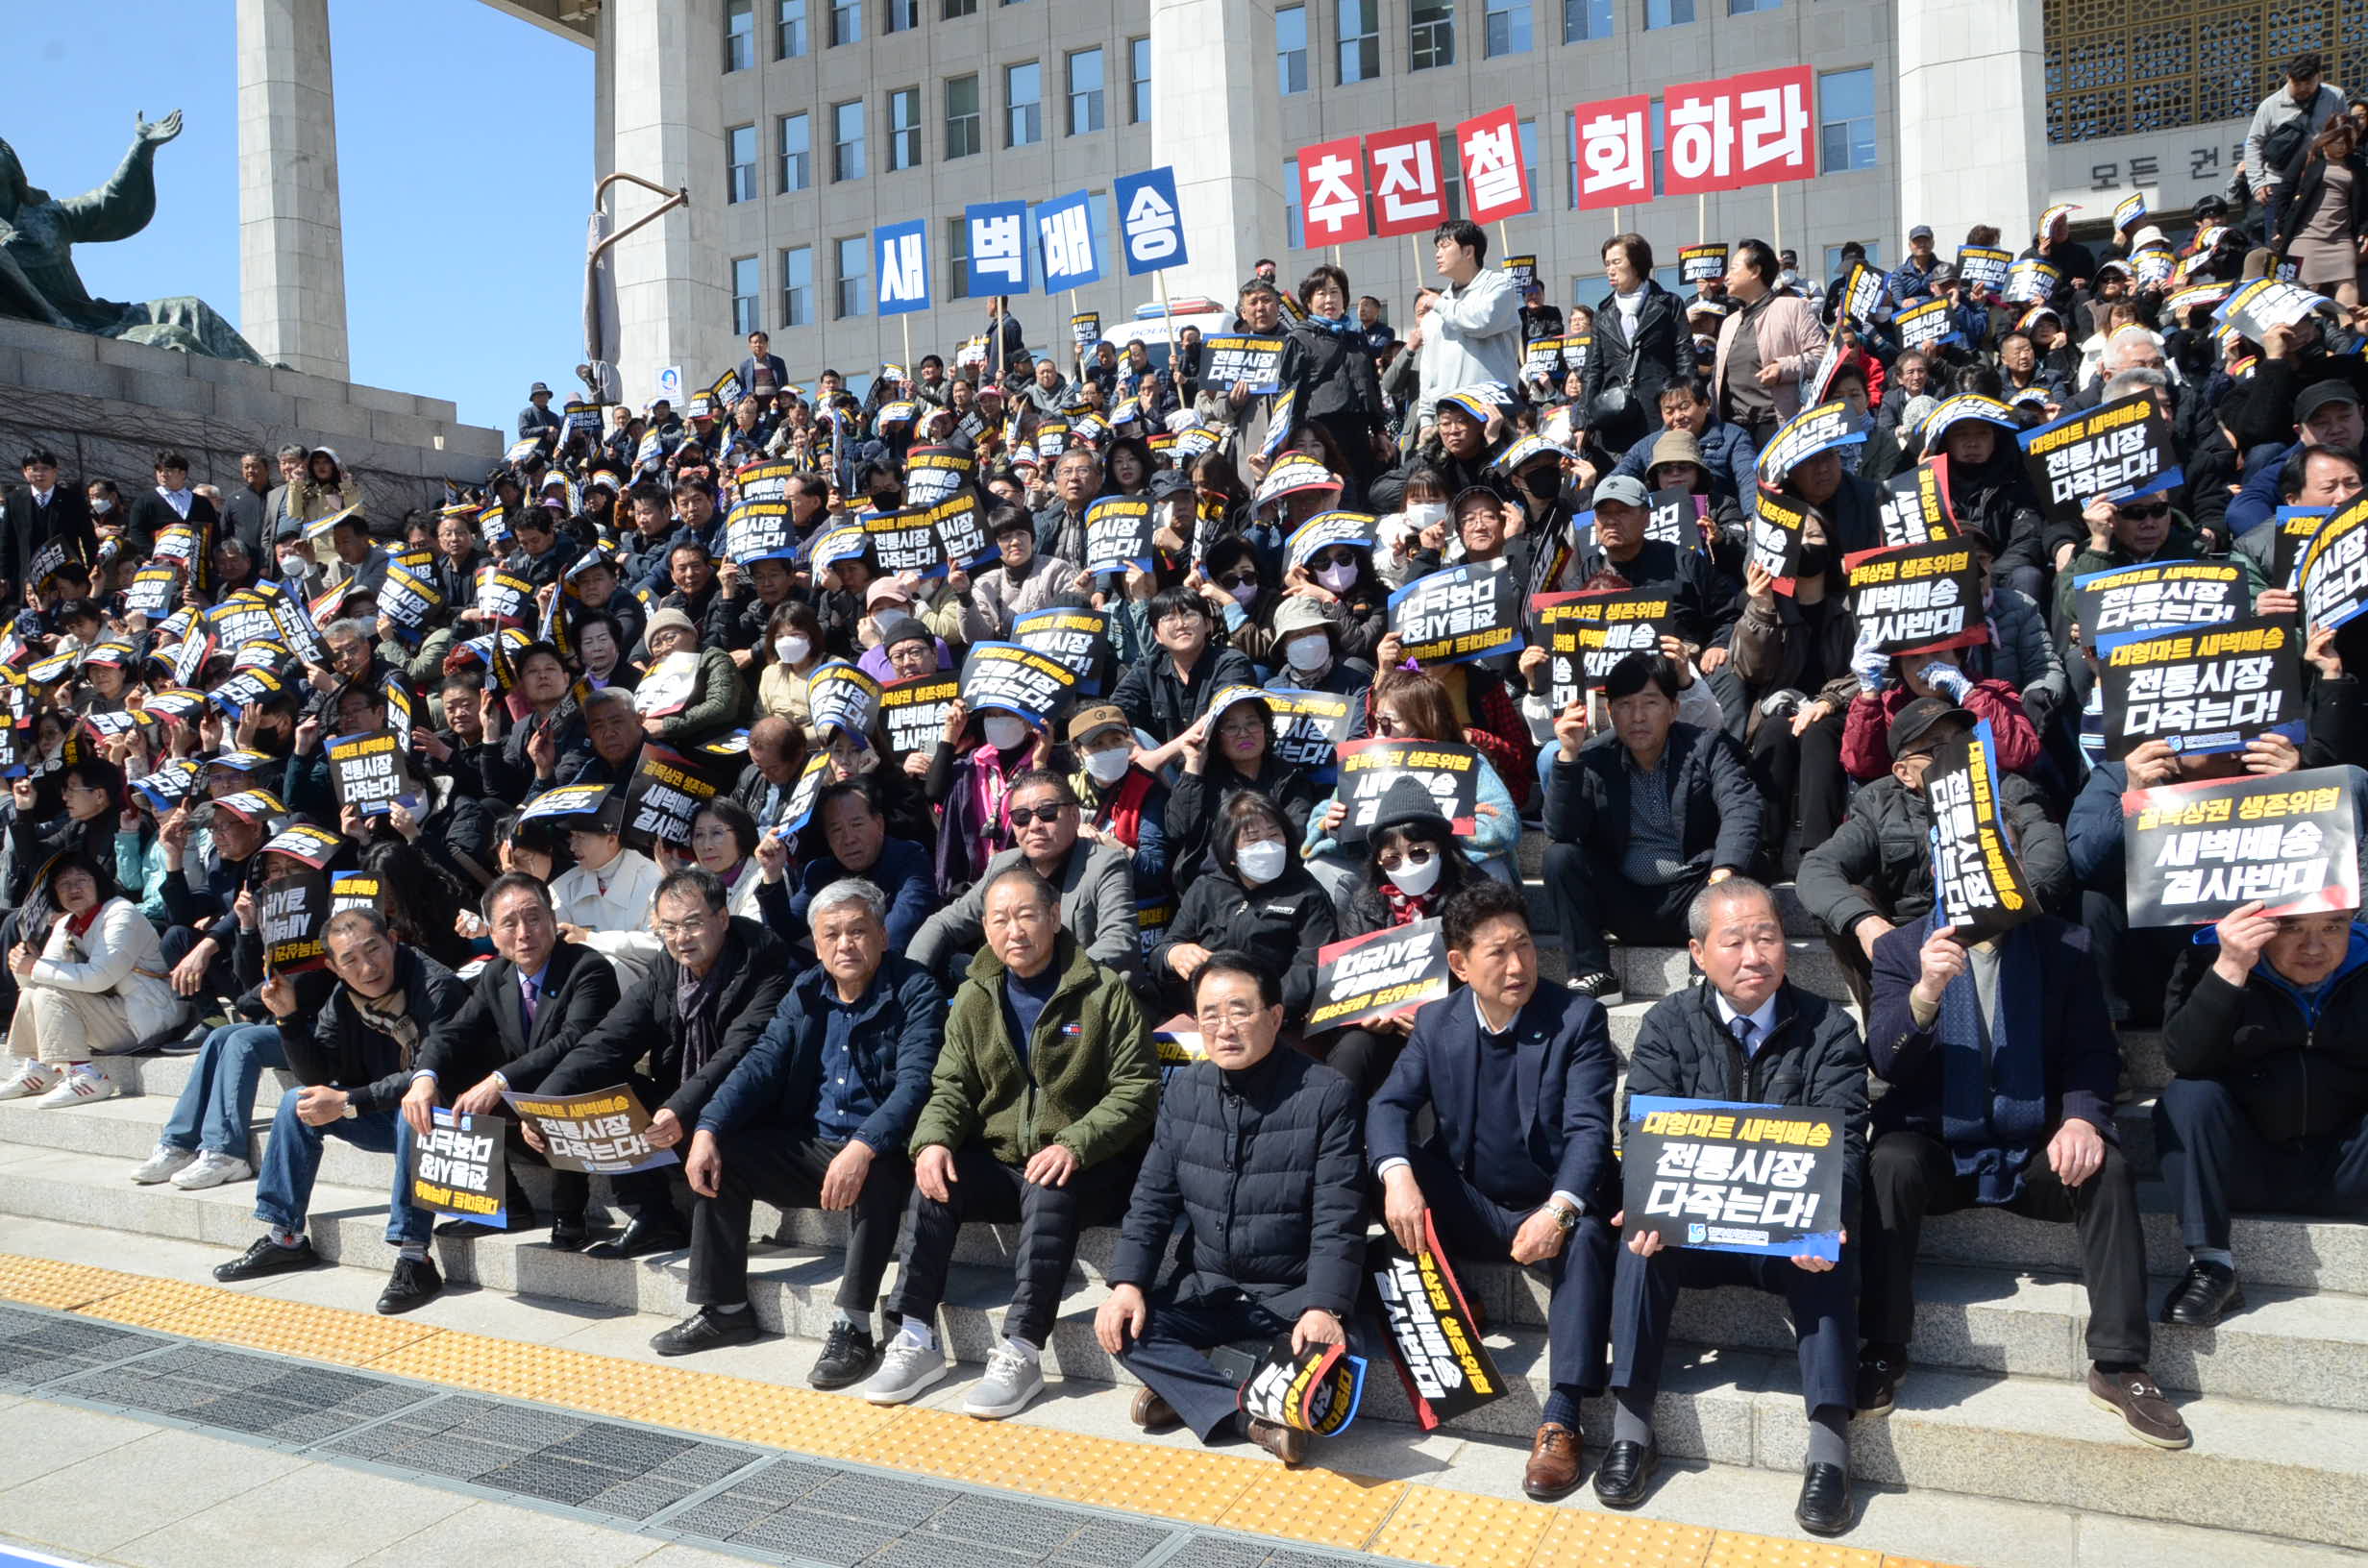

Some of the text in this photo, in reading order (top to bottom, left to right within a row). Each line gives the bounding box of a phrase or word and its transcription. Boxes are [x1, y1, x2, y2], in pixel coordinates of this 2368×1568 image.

[1307, 155, 1360, 232] 추
[1373, 138, 1440, 222] 진
[1464, 122, 1523, 210] 철
[1583, 111, 1645, 194] 회
[2091, 156, 2159, 191] 모든
[880, 185, 1174, 303] 새 벽 배 송
[1963, 257, 2007, 272] 전통시장
[1902, 309, 1945, 336] 전통시장
[1207, 366, 1277, 382] 다죽는다!
[1213, 351, 1276, 367] 전통시장
[2030, 400, 2151, 455] 대형마트 새벽배송
[2045, 424, 2146, 478] 전통시장
[2052, 447, 2158, 504] 다죽는다!
[1763, 499, 1803, 530] 생존위협
[874, 529, 930, 551] 전통시장
[877, 547, 936, 568] 다죽는다!
[1850, 551, 1968, 586] 골목상권 생존위협
[2085, 567, 2238, 592] 대형마트 새벽배송
[1605, 600, 1667, 621] 생존위협
[1857, 577, 1959, 616] 새벽배송
[2101, 581, 2229, 608] 전통시장
[1055, 615, 1103, 632] 새벽배송
[1402, 602, 1496, 644] 전통시장
[2096, 602, 2235, 630] 다죽는다!
[1021, 631, 1094, 654] 전통시장
[1605, 624, 1656, 649] 배송
[2109, 626, 2284, 667] 대형마트 새벽배송
[973, 659, 1061, 696] 전통시장
[1023, 655, 1074, 686] 새벽배송
[2127, 656, 2273, 701] 전통시장
[915, 682, 958, 701] 생존위협
[962, 676, 1055, 713] 다죽는다!
[888, 703, 951, 729] 새벽배송
[2123, 691, 2282, 736] 다죽는다!
[340, 753, 393, 781] 전통시장
[1274, 739, 1334, 765] 는다!
[1408, 751, 1472, 772] 생존위협
[344, 774, 400, 803] 다죽는다!
[642, 760, 683, 788] 골목상권
[1968, 741, 2023, 910] 대형마트 새벽배송
[2137, 787, 2340, 830] 골목상권 생존위협
[1930, 778, 1975, 926] 다죽는다!
[1946, 769, 1997, 908] 전통시장
[2155, 821, 2323, 867] 새벽배송
[2160, 857, 2330, 905] 결사반대
[536, 1115, 631, 1139] 전통시장
[1641, 1112, 1832, 1147] 대형마트 새벽배송
[417, 1129, 493, 1163] 다죽는다!
[549, 1133, 651, 1161] 다죽는다!
[419, 1153, 488, 1191] 전통시장
[1655, 1142, 1816, 1188] 전통시장
[415, 1180, 499, 1214] 대형마트 새벽배송
[1644, 1181, 1821, 1228] 다죽는다!
[1374, 1268, 1445, 1398] 결사반대
[1392, 1257, 1463, 1388] 새벽배송
[1418, 1251, 1493, 1394] 목상권 생존위협
